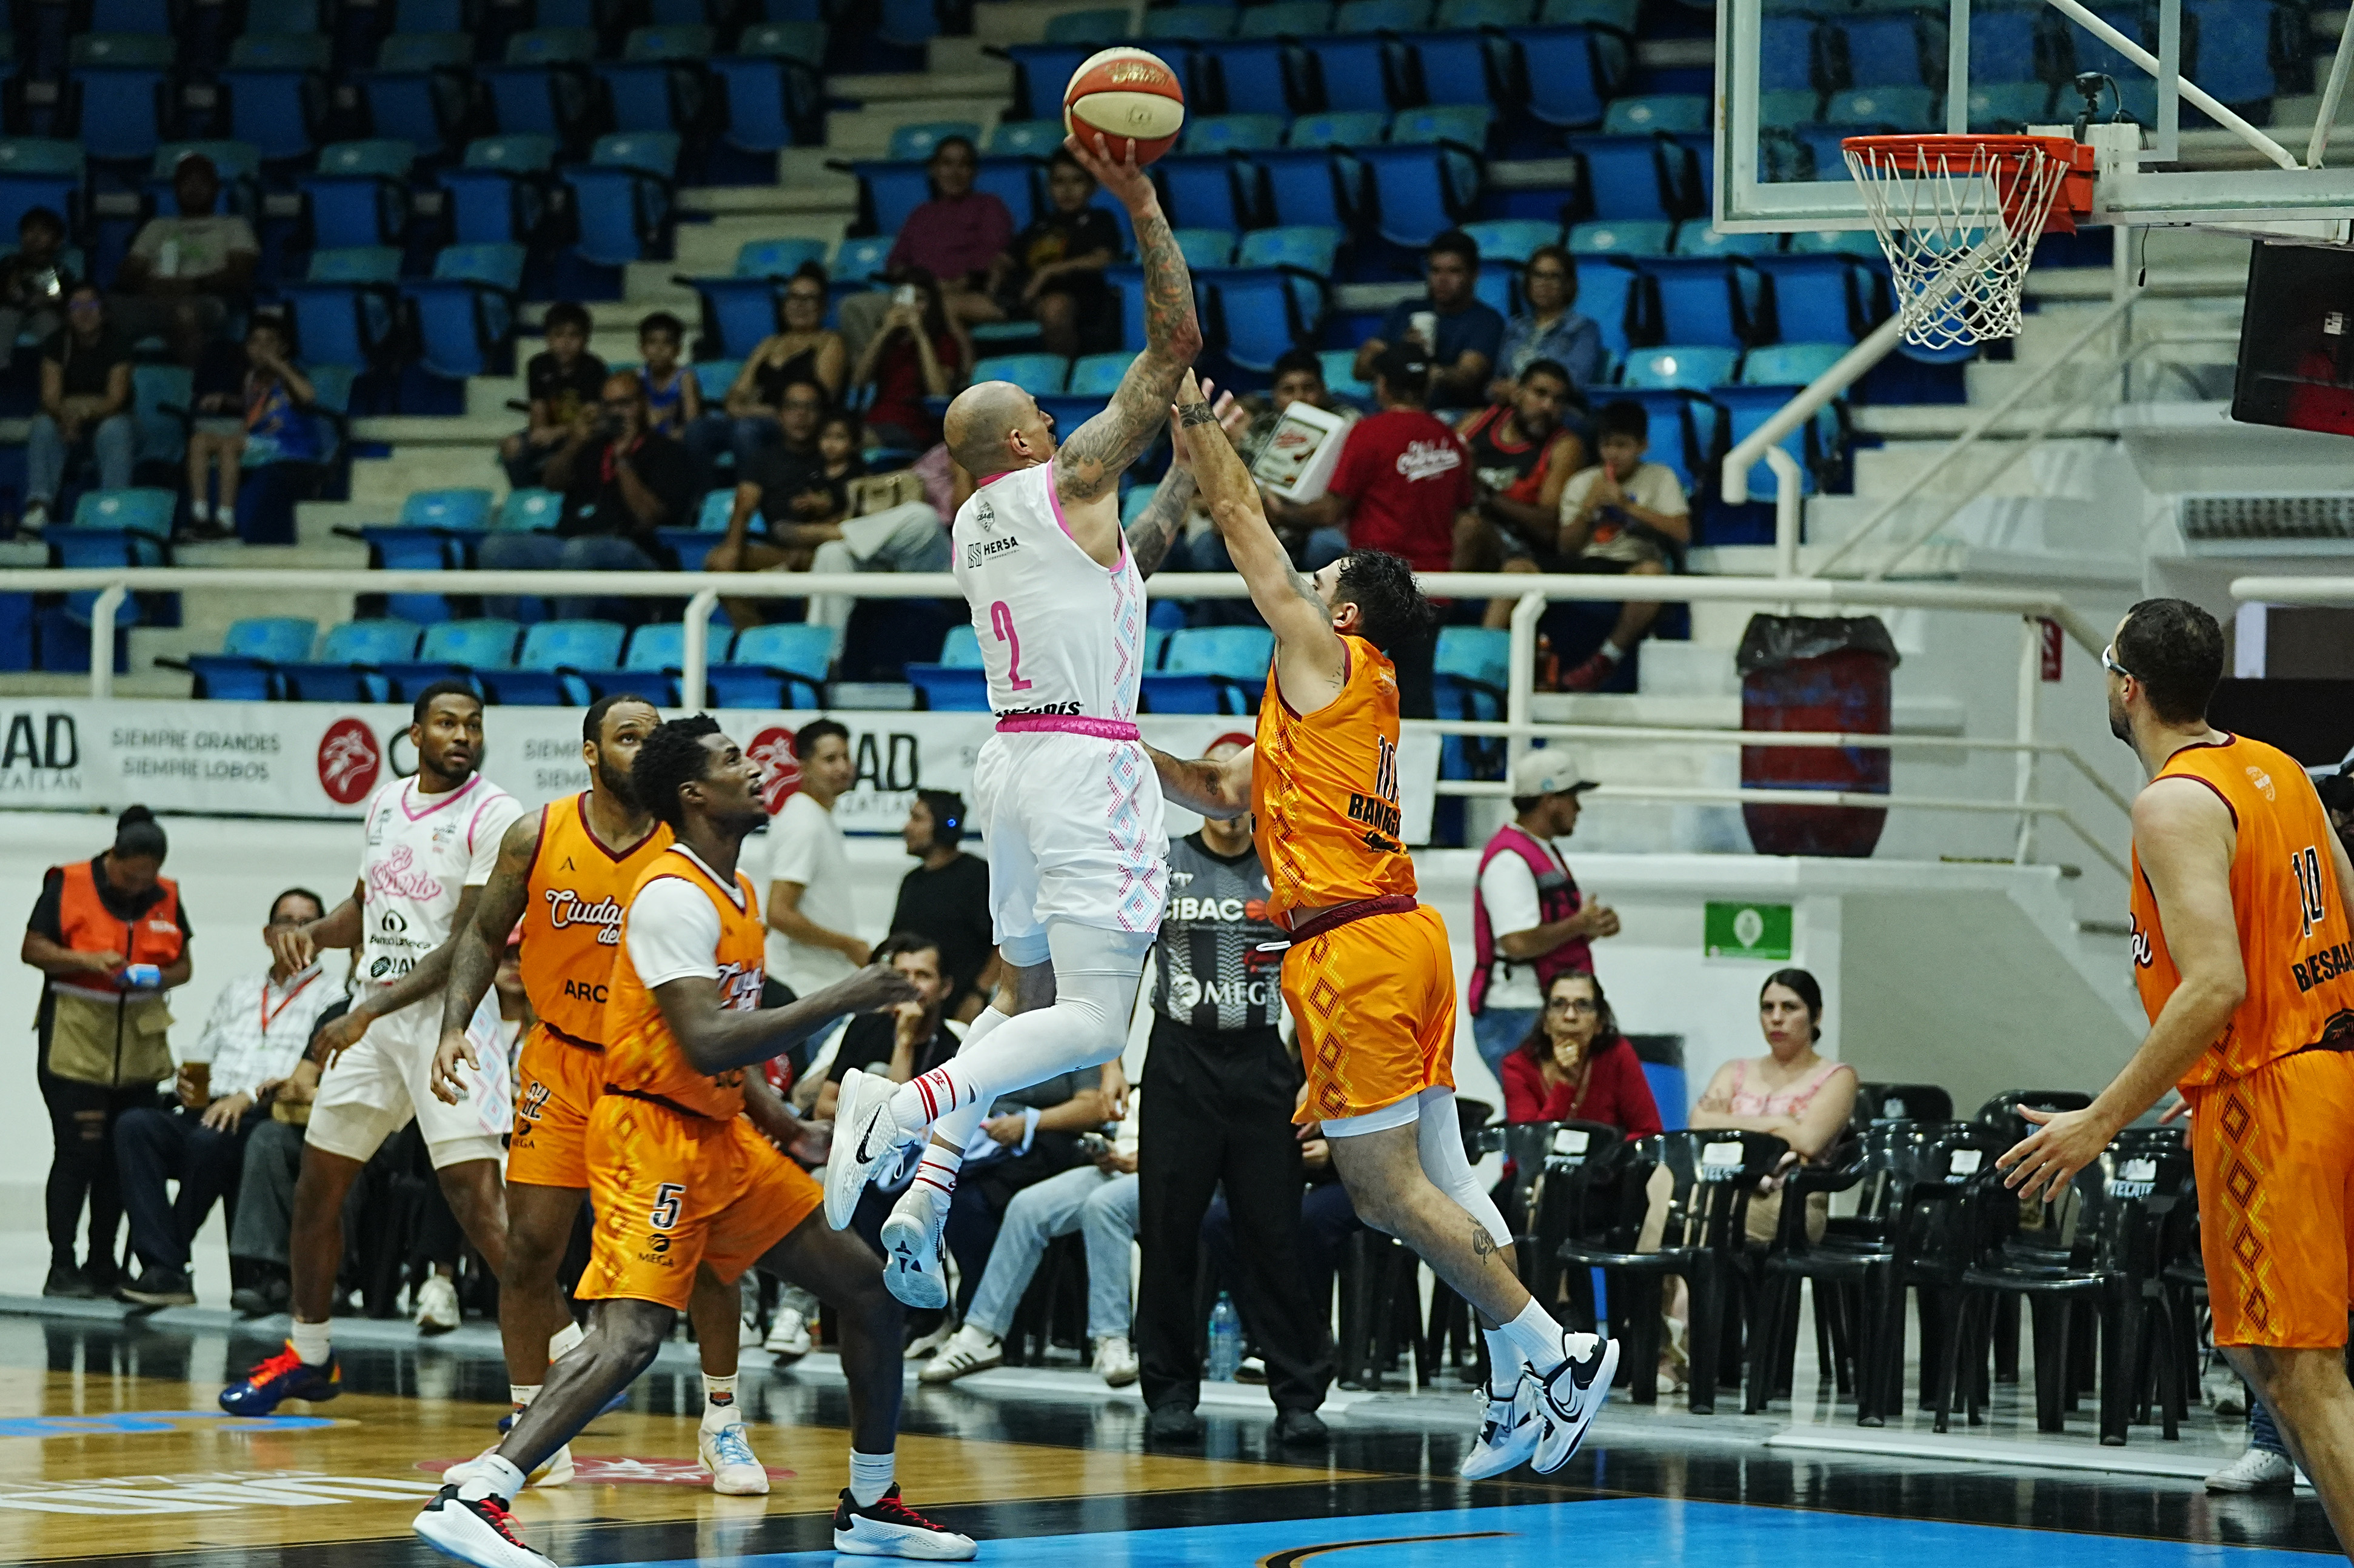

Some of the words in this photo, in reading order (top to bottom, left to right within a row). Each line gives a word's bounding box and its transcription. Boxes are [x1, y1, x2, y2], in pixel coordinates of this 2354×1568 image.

[984, 536, 1018, 555] HERSA
[991, 601, 1032, 691] 2
[112, 730, 189, 749] SIEMPRE
[194, 732, 281, 753] GRANDES
[123, 758, 199, 779] SIEMPRE
[205, 761, 270, 782] LOBOS
[854, 734, 918, 790] AD
[564, 979, 609, 1004] ARC
[649, 1183, 686, 1230] 5
